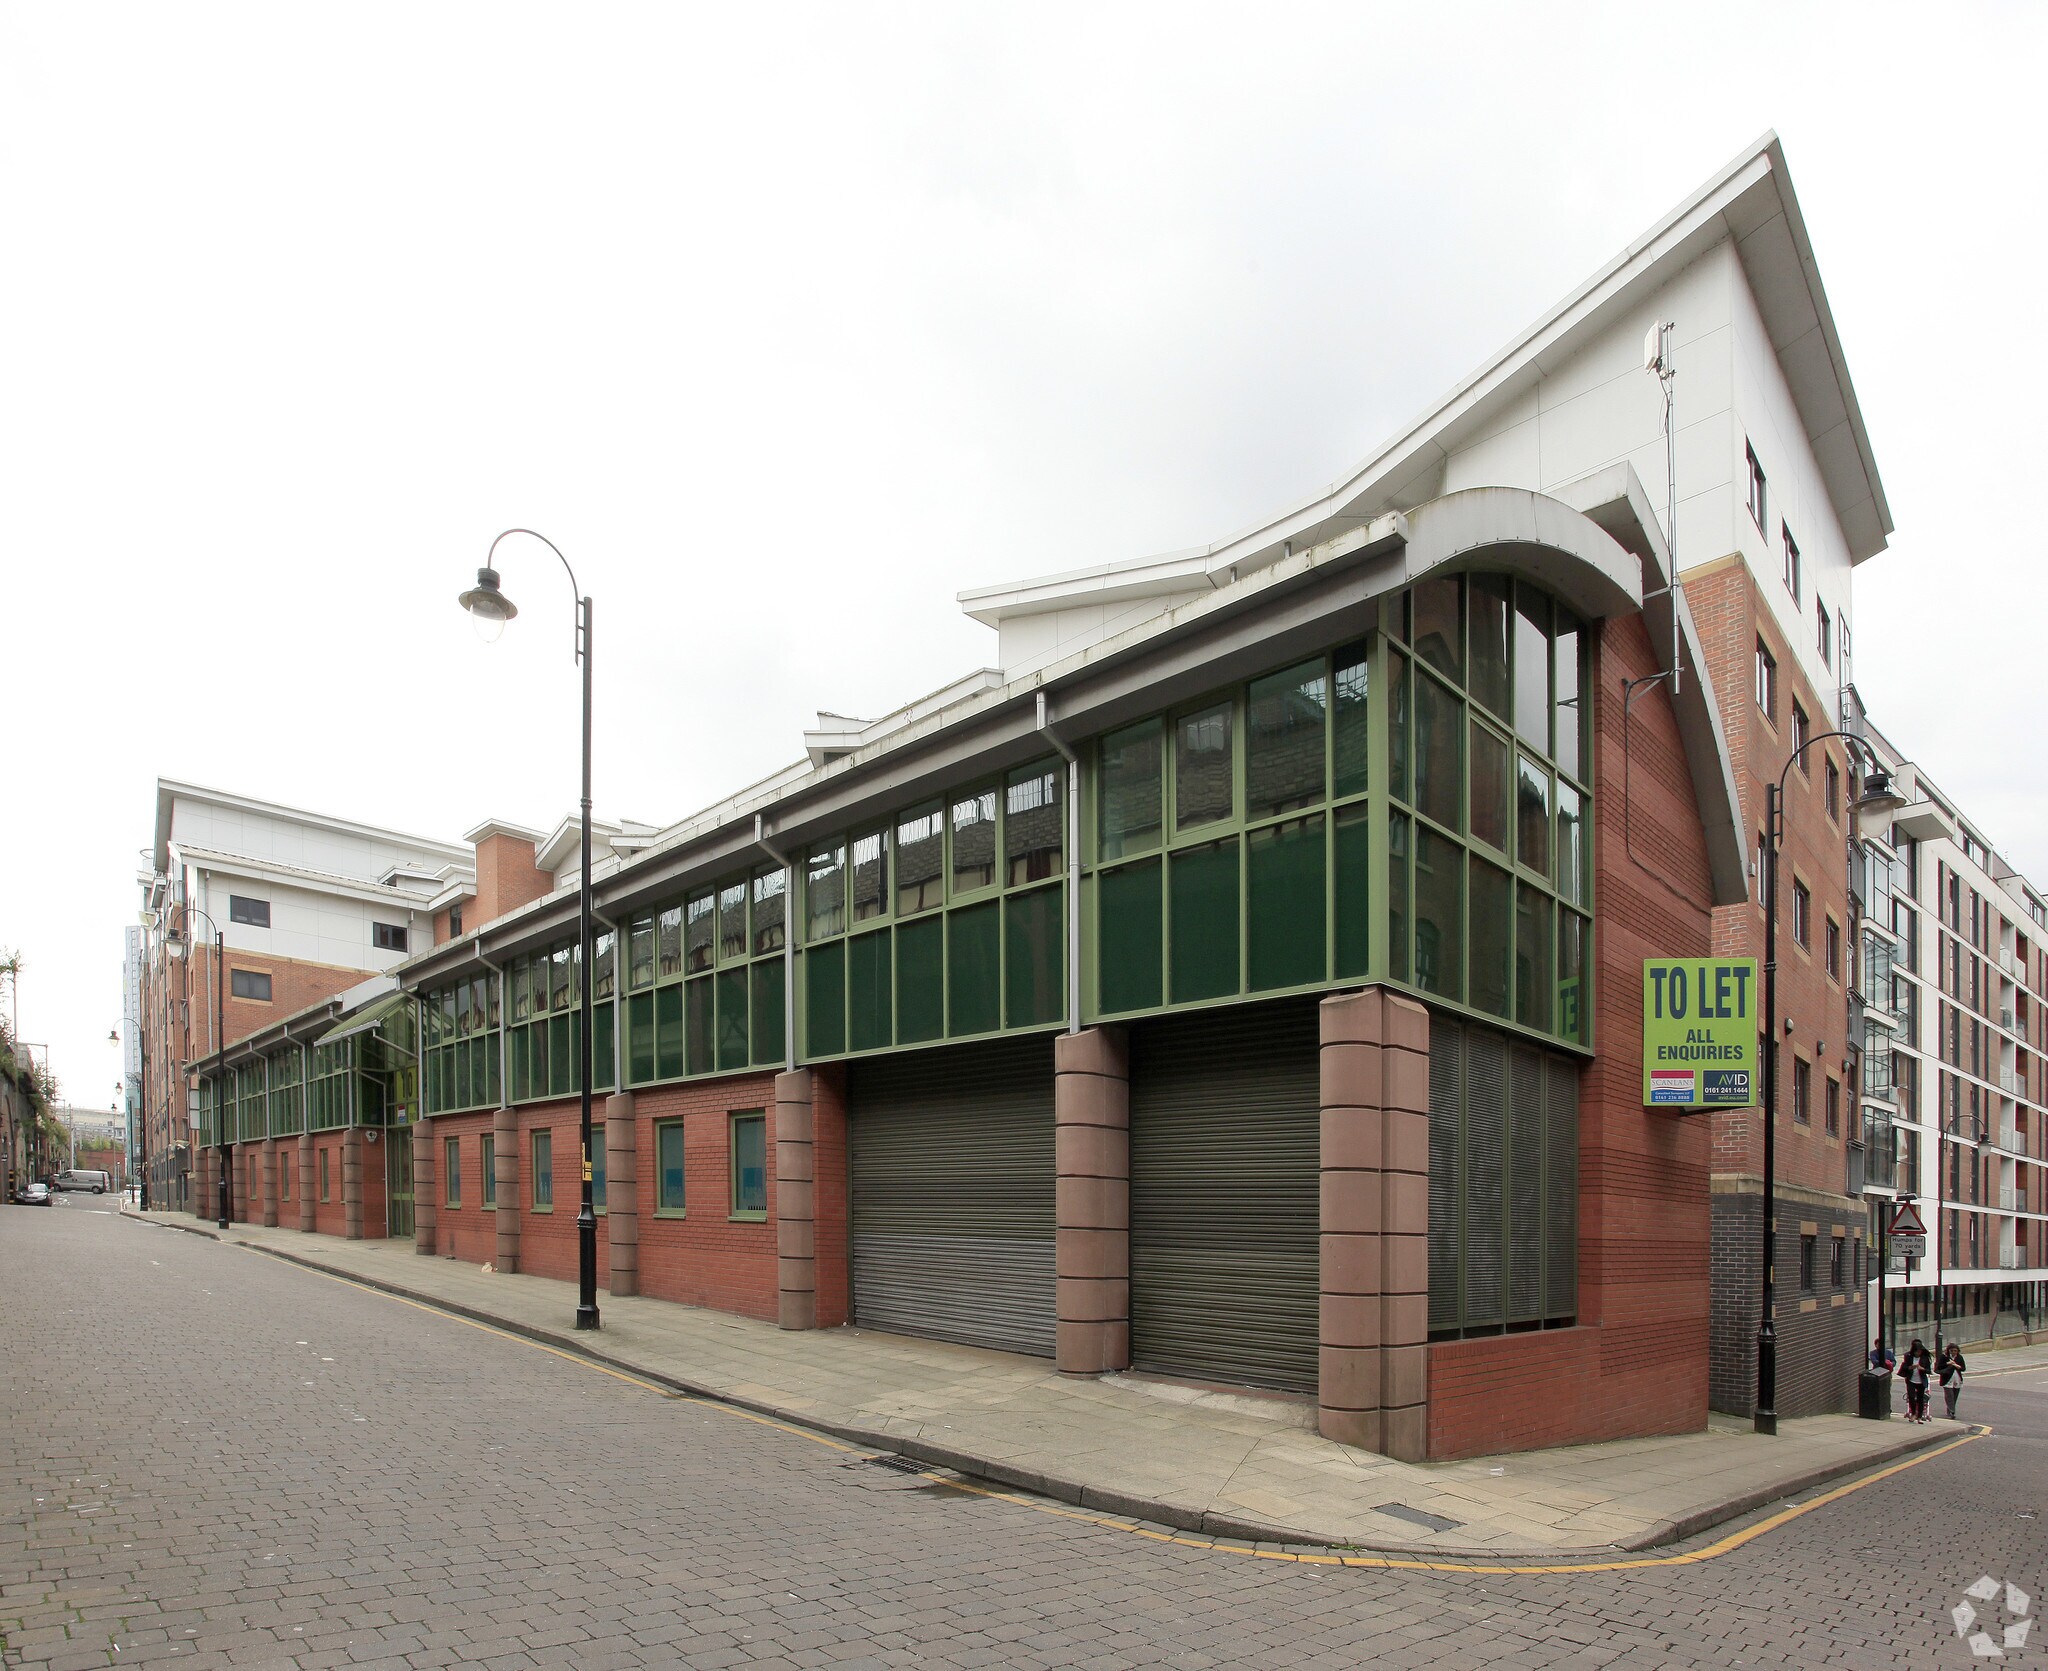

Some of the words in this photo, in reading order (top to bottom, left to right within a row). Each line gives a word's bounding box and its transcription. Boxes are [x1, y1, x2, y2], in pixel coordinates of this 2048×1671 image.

[1650, 966, 1687, 1020] TO
[1698, 966, 1750, 1019] LET
[1686, 1029, 1715, 1044] ALL
[1657, 1045, 1744, 1061] ENQUIRIES
[1718, 1074, 1748, 1086] AVID
